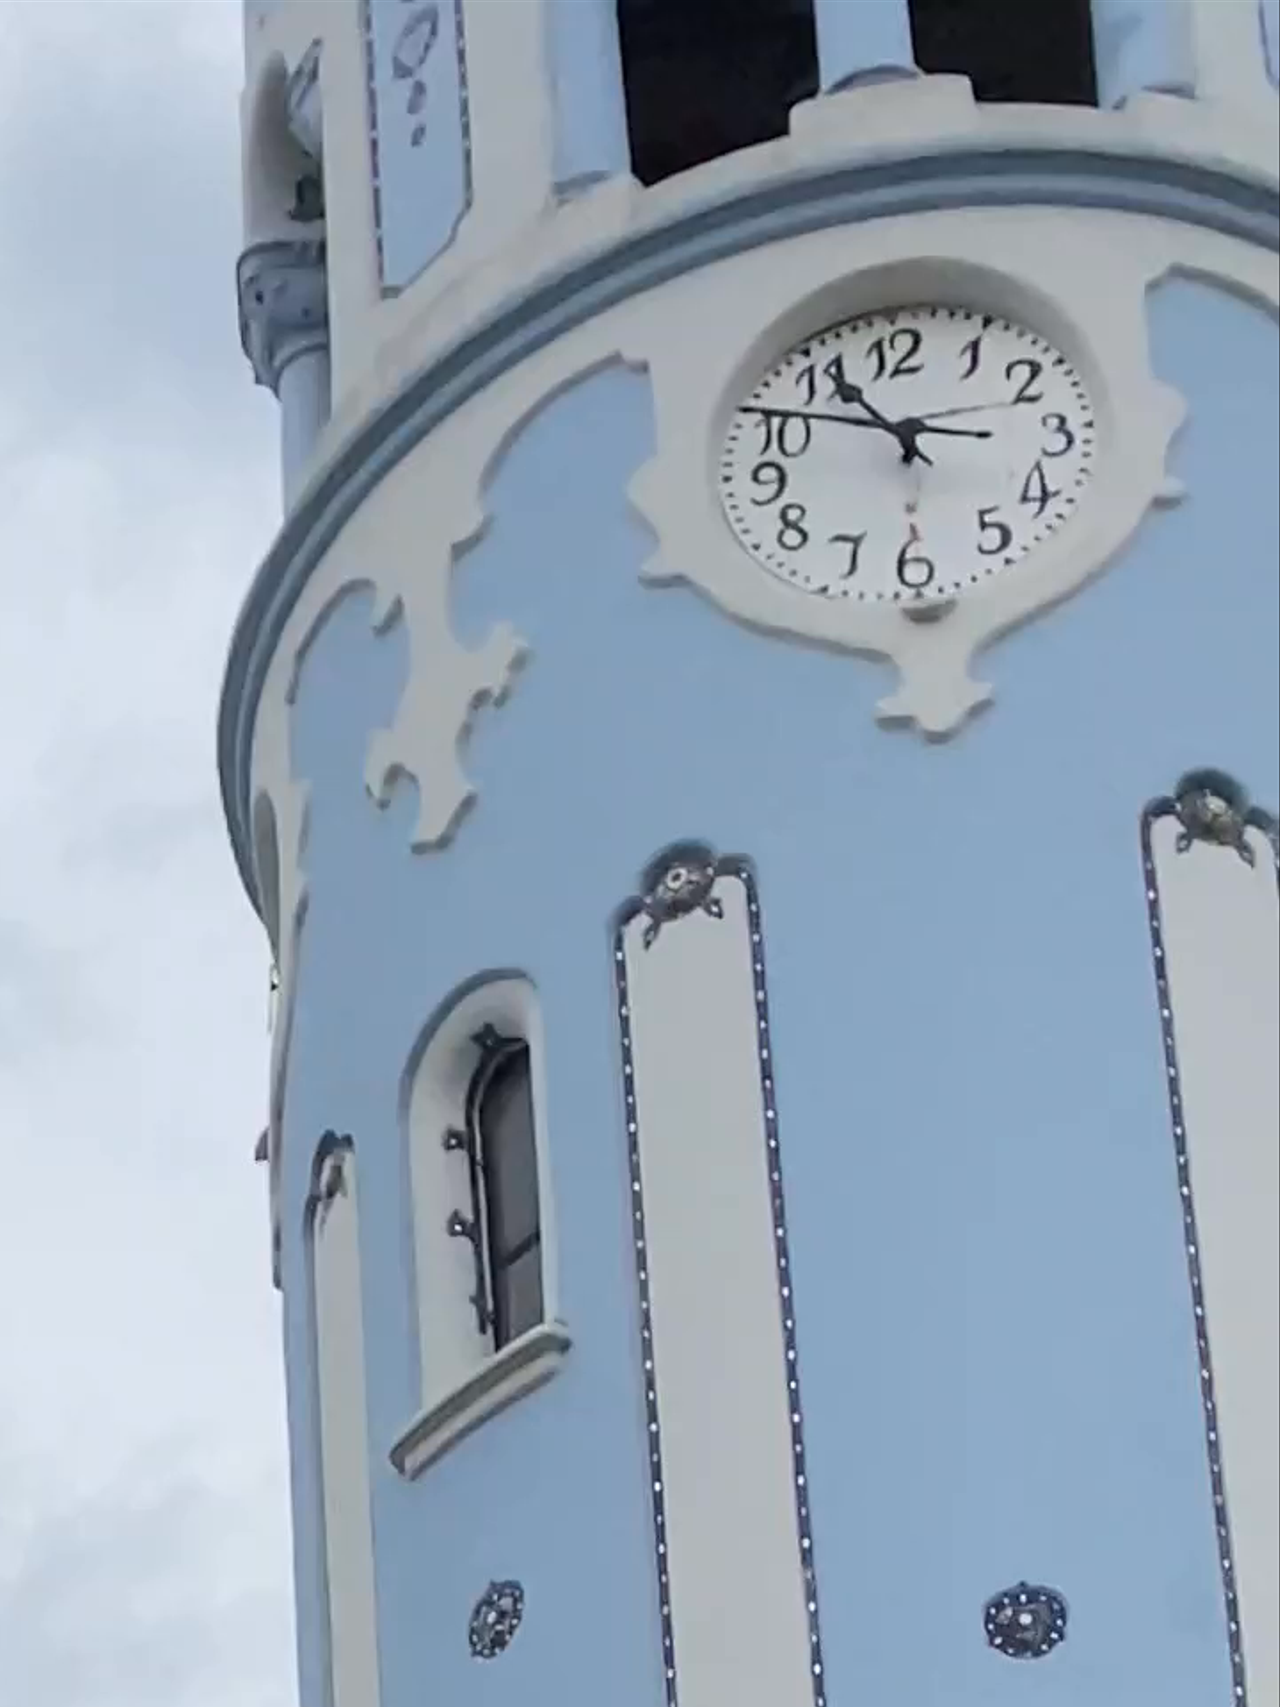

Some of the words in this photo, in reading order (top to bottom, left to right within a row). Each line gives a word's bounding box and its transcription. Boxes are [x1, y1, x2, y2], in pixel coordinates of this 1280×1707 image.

[866, 327, 924, 382] 12
[959, 335, 984, 381] 1
[1005, 358, 1044, 405] 2
[757, 413, 810, 458] 10
[1040, 413, 1075, 458] 3
[750, 461, 787, 507] 9
[1018, 460, 1064, 520] 4
[777, 503, 809, 551] 8
[977, 506, 1013, 555] 5
[827, 529, 868, 577] 7
[896, 528, 935, 589] 6
